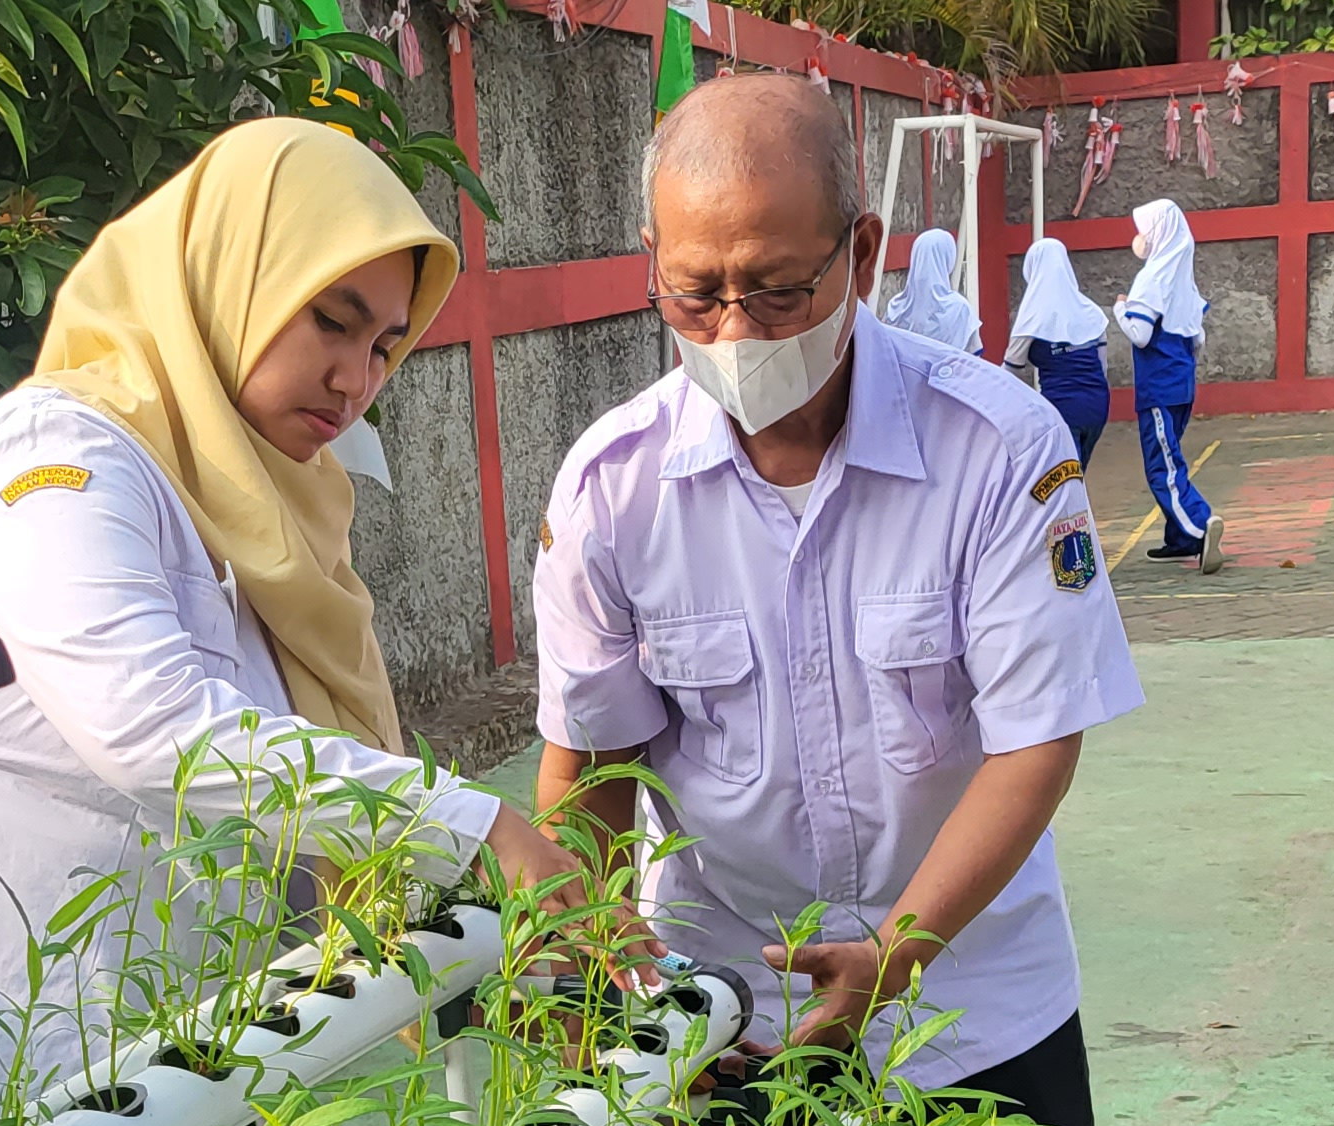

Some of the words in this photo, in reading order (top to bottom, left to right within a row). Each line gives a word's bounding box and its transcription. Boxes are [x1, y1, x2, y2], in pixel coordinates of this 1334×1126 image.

[4, 467, 85, 493] KEMENTERIAN
[7, 479, 39, 500] DALAM
[1053, 521, 1072, 536] JAYA
